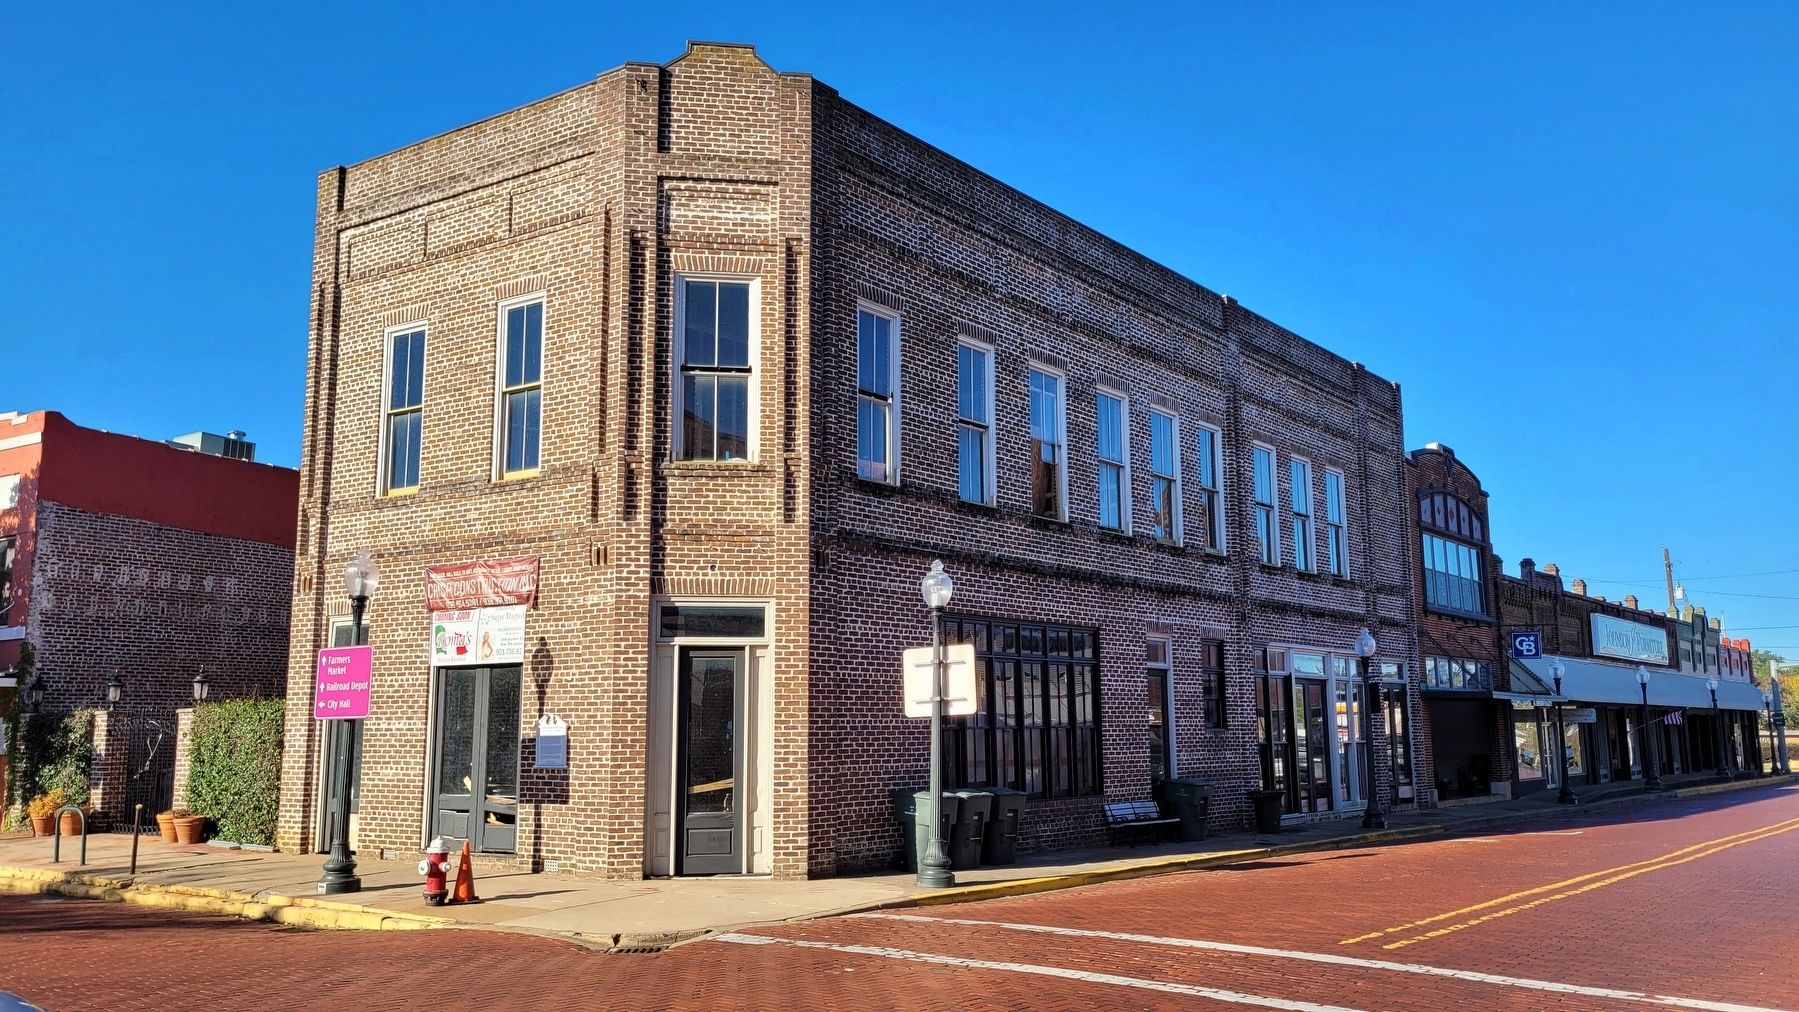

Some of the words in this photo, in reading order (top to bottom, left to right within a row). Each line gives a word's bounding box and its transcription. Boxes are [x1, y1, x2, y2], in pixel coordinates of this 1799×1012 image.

[456, 611, 470, 621] SOON
[328, 656, 351, 665] Farmers
[327, 666, 347, 675] Market
[326, 682, 350, 692] Railroad
[351, 681, 369, 692] Depot
[327, 700, 338, 711] City
[339, 699, 351, 709] Hall
